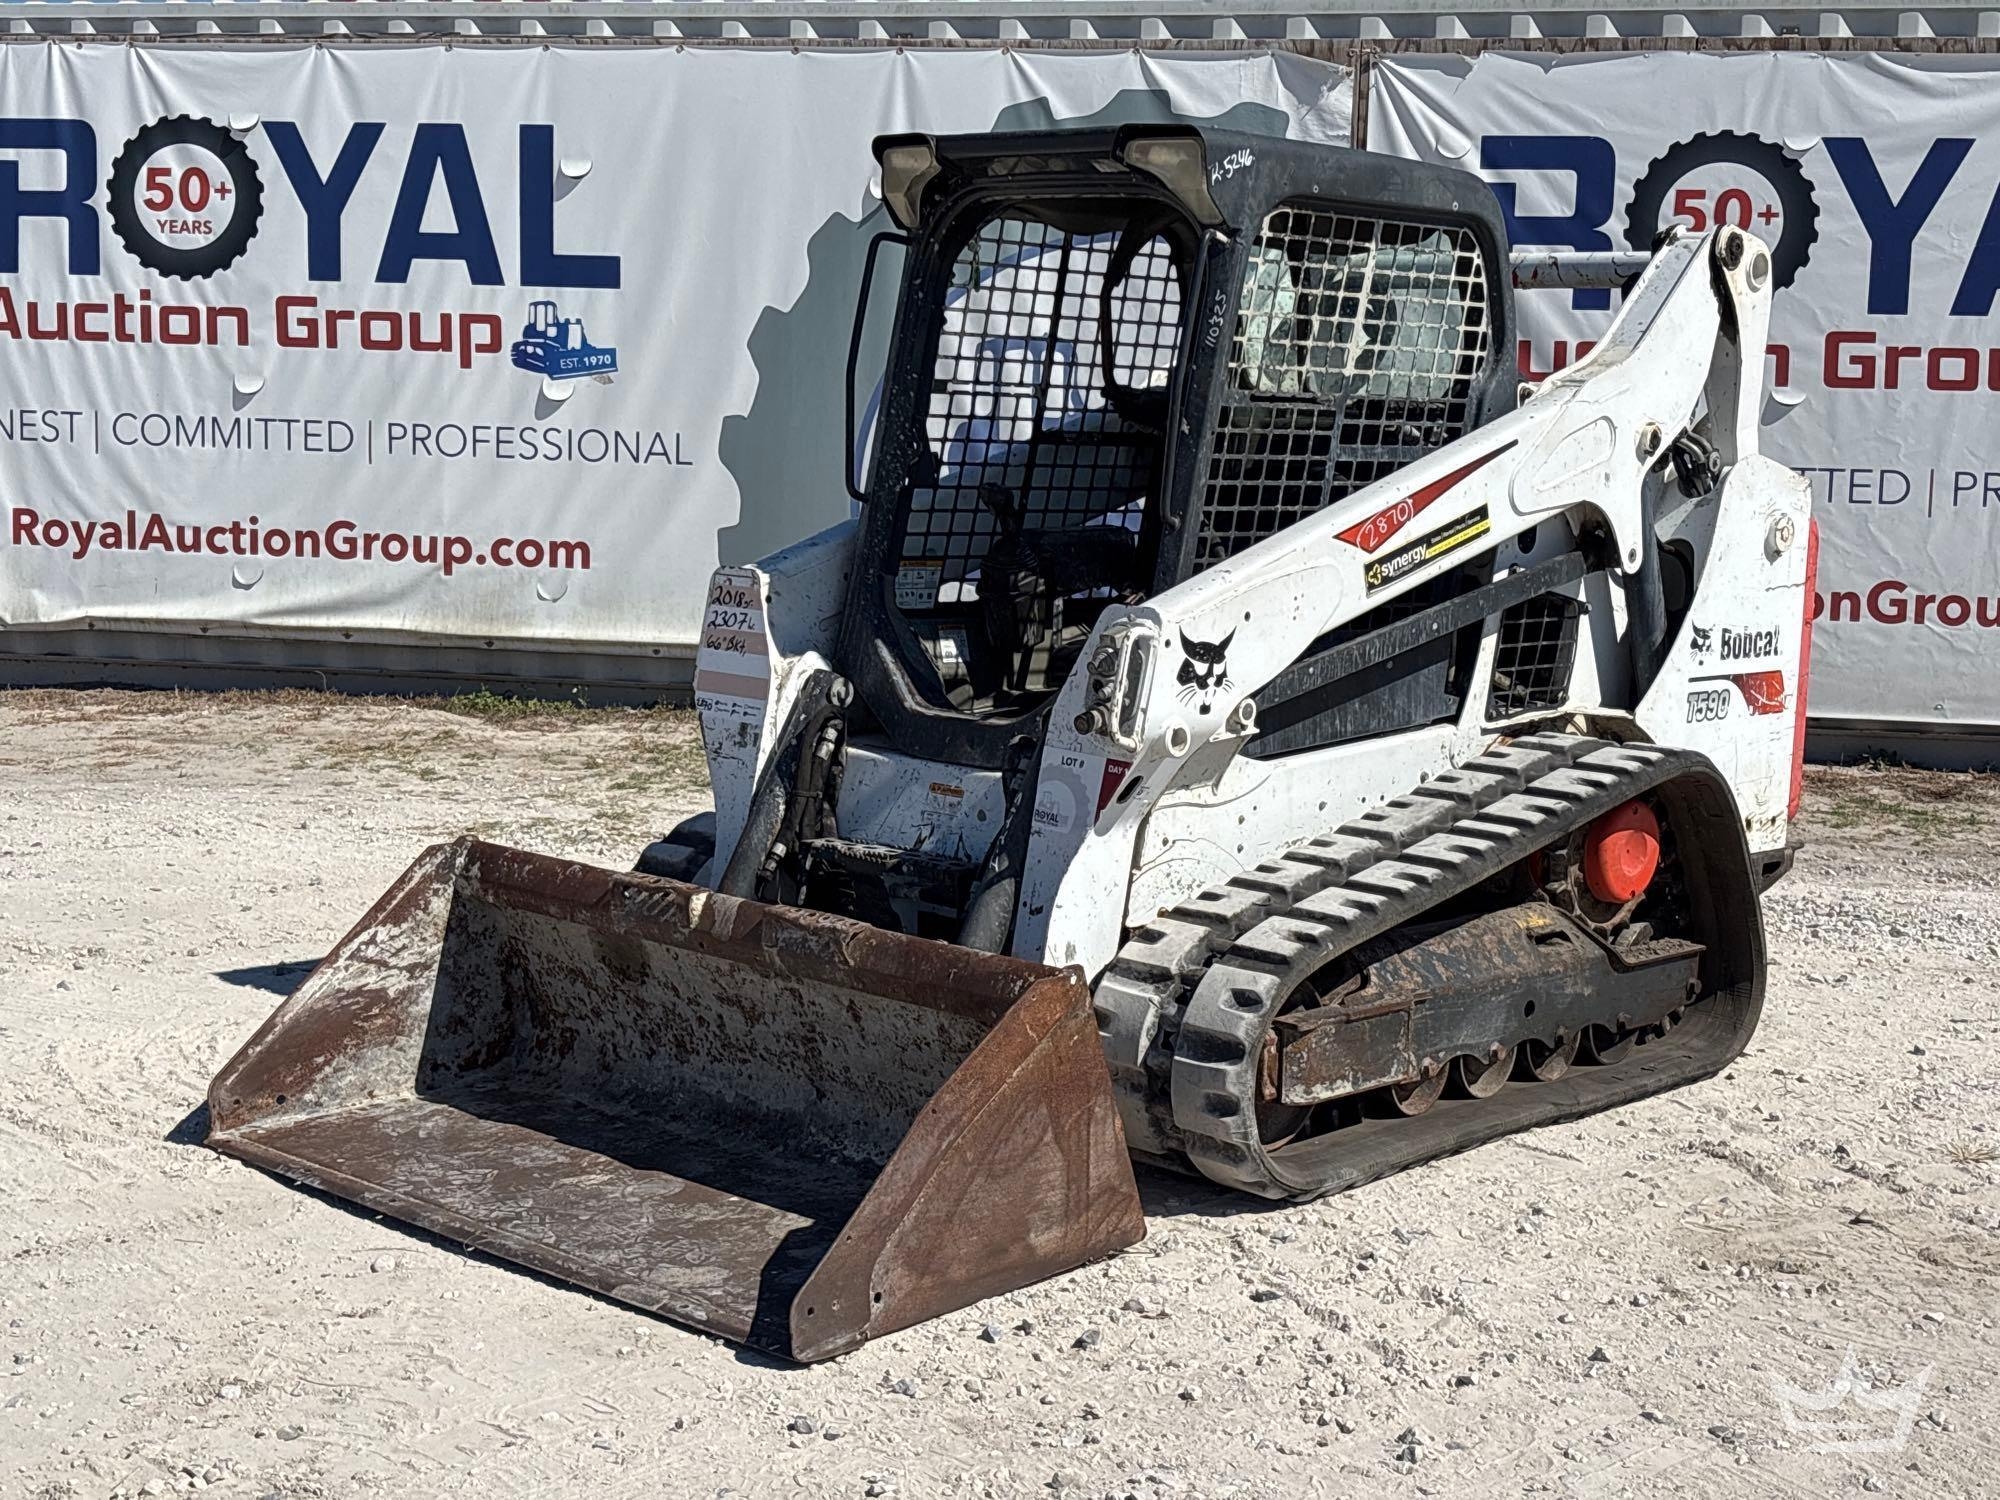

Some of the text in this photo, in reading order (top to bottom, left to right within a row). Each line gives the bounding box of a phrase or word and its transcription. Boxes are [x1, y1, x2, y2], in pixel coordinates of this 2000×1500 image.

[143, 167, 232, 213] 50+
[156, 219, 213, 235] YEARS
[274, 294, 502, 369] Group
[560, 354, 611, 369] EST. 1970
[1823, 331, 2000, 392] Gro
[112, 412, 354, 453] COMMITTED
[388, 422, 693, 466] PROFESSIONAL
[12, 507, 591, 576] RoyalAuctionGroup.com
[1381, 543, 1427, 577] synergy
[1687, 689, 1730, 723] T590
[1061, 756, 1078, 768] LOT
[1108, 765, 1123, 775] DAY
[1034, 809, 1060, 823] ROYAL
